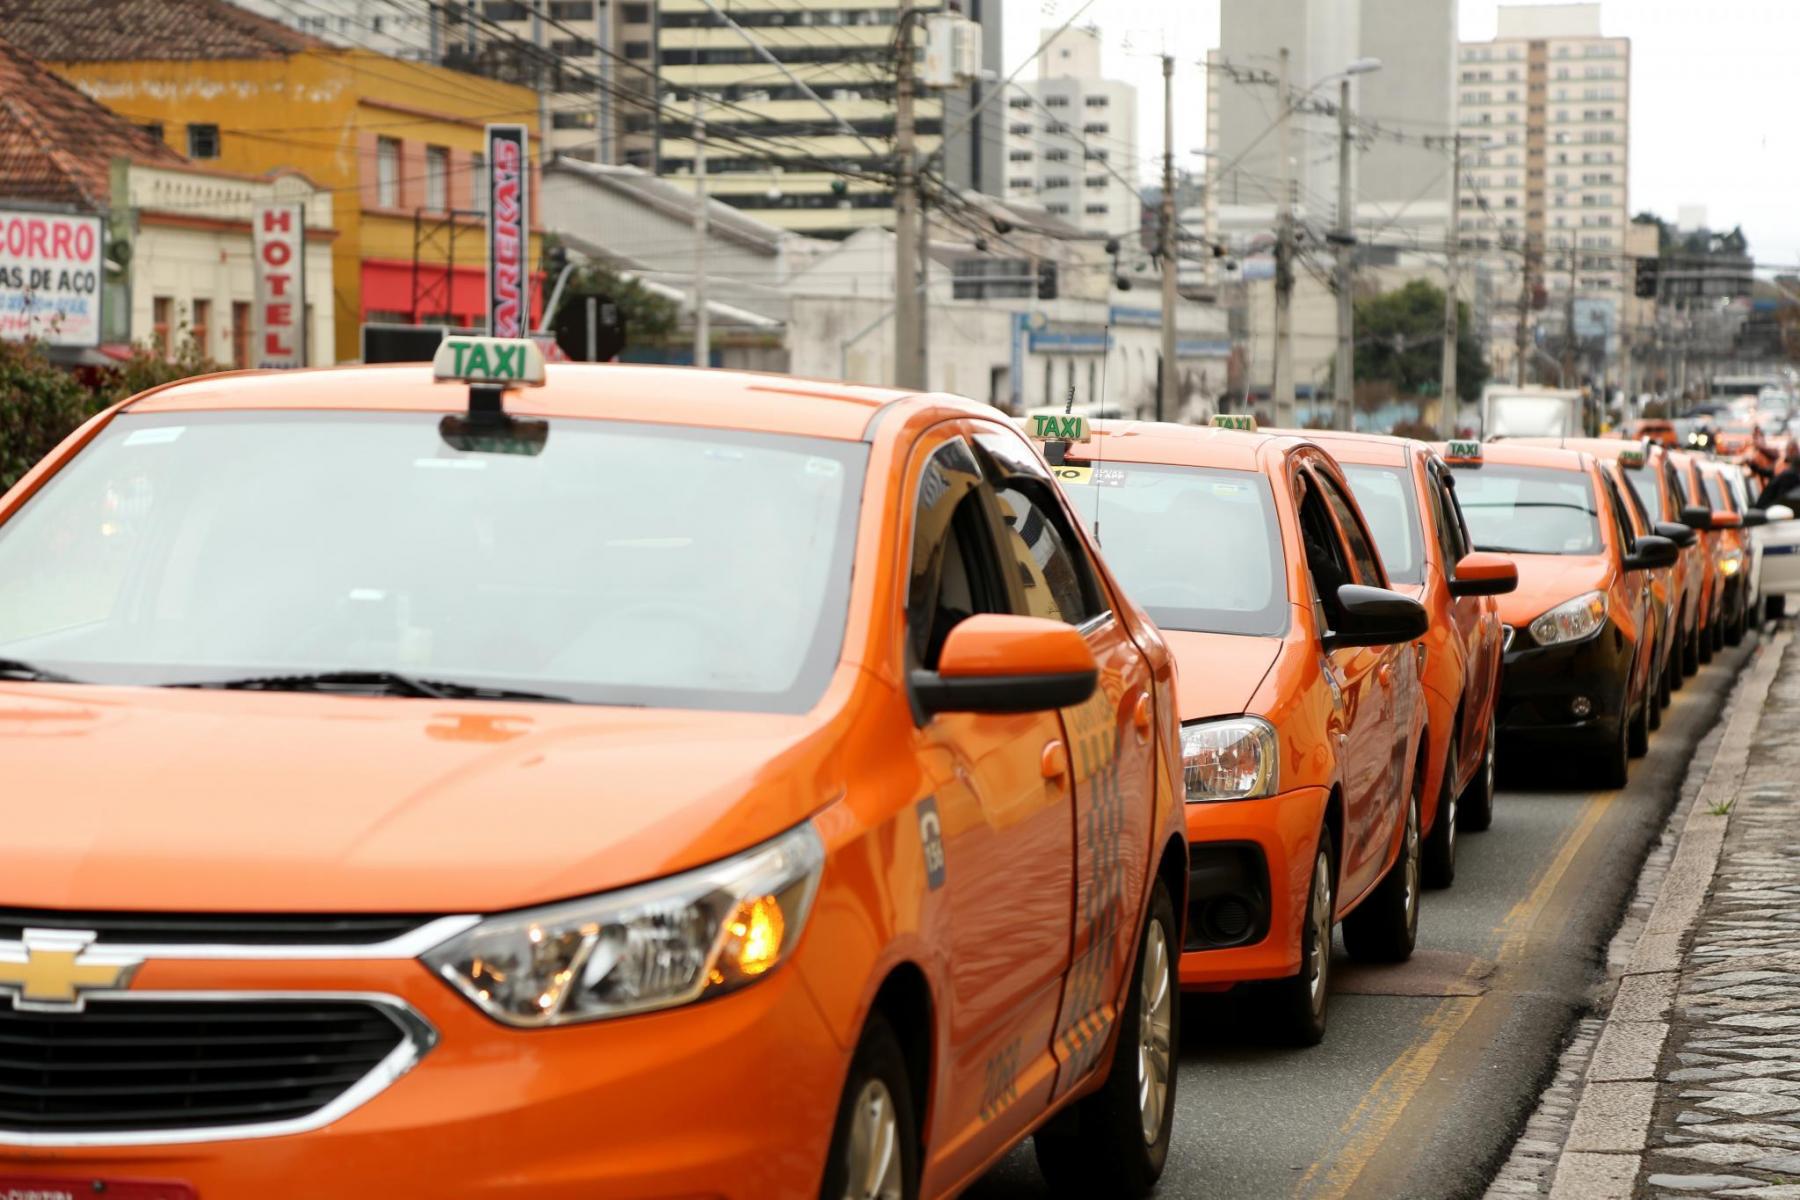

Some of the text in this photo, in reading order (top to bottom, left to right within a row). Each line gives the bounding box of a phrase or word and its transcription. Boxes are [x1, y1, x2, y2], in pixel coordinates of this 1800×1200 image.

[30, 268, 51, 290] DE
[58, 270, 95, 294] AÇO
[263, 209, 292, 355] HOTEL
[448, 342, 526, 379] TAXI
[1033, 415, 1082, 438] TAXI
[1215, 416, 1251, 430] TAXI
[1450, 442, 1479, 457] TAXI
